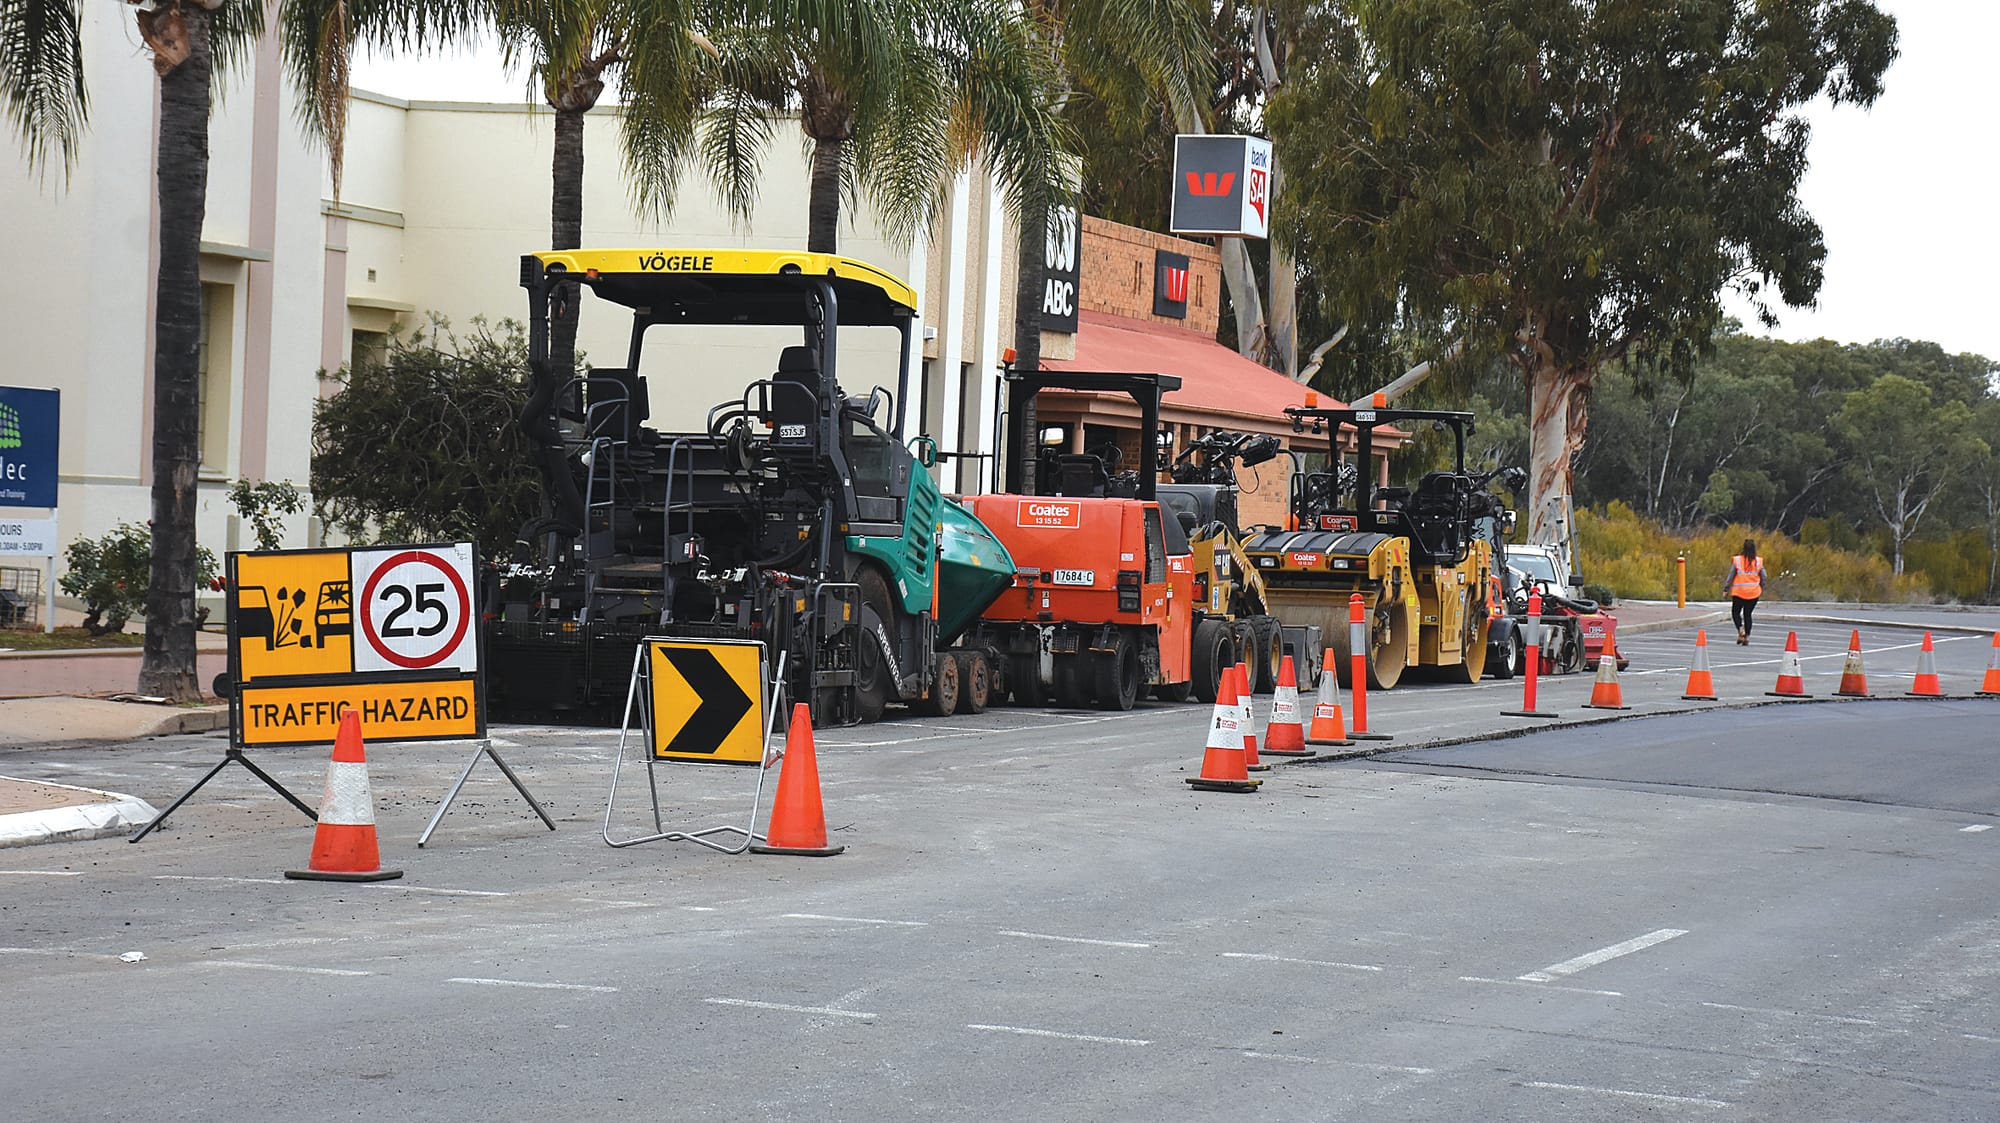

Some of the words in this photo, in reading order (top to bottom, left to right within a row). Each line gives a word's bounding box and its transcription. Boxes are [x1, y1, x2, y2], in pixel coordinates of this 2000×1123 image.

[1251, 147, 1267, 168] bank
[1250, 172, 1264, 204] SA
[639, 252, 713, 271] VÖGELE
[1043, 279, 1073, 317] ABC
[1029, 504, 1070, 517] Coates
[1294, 553, 1317, 561] Coates
[379, 583, 449, 638] 25
[250, 700, 352, 728] TRAFFIC
[363, 696, 468, 723] HAZARD
